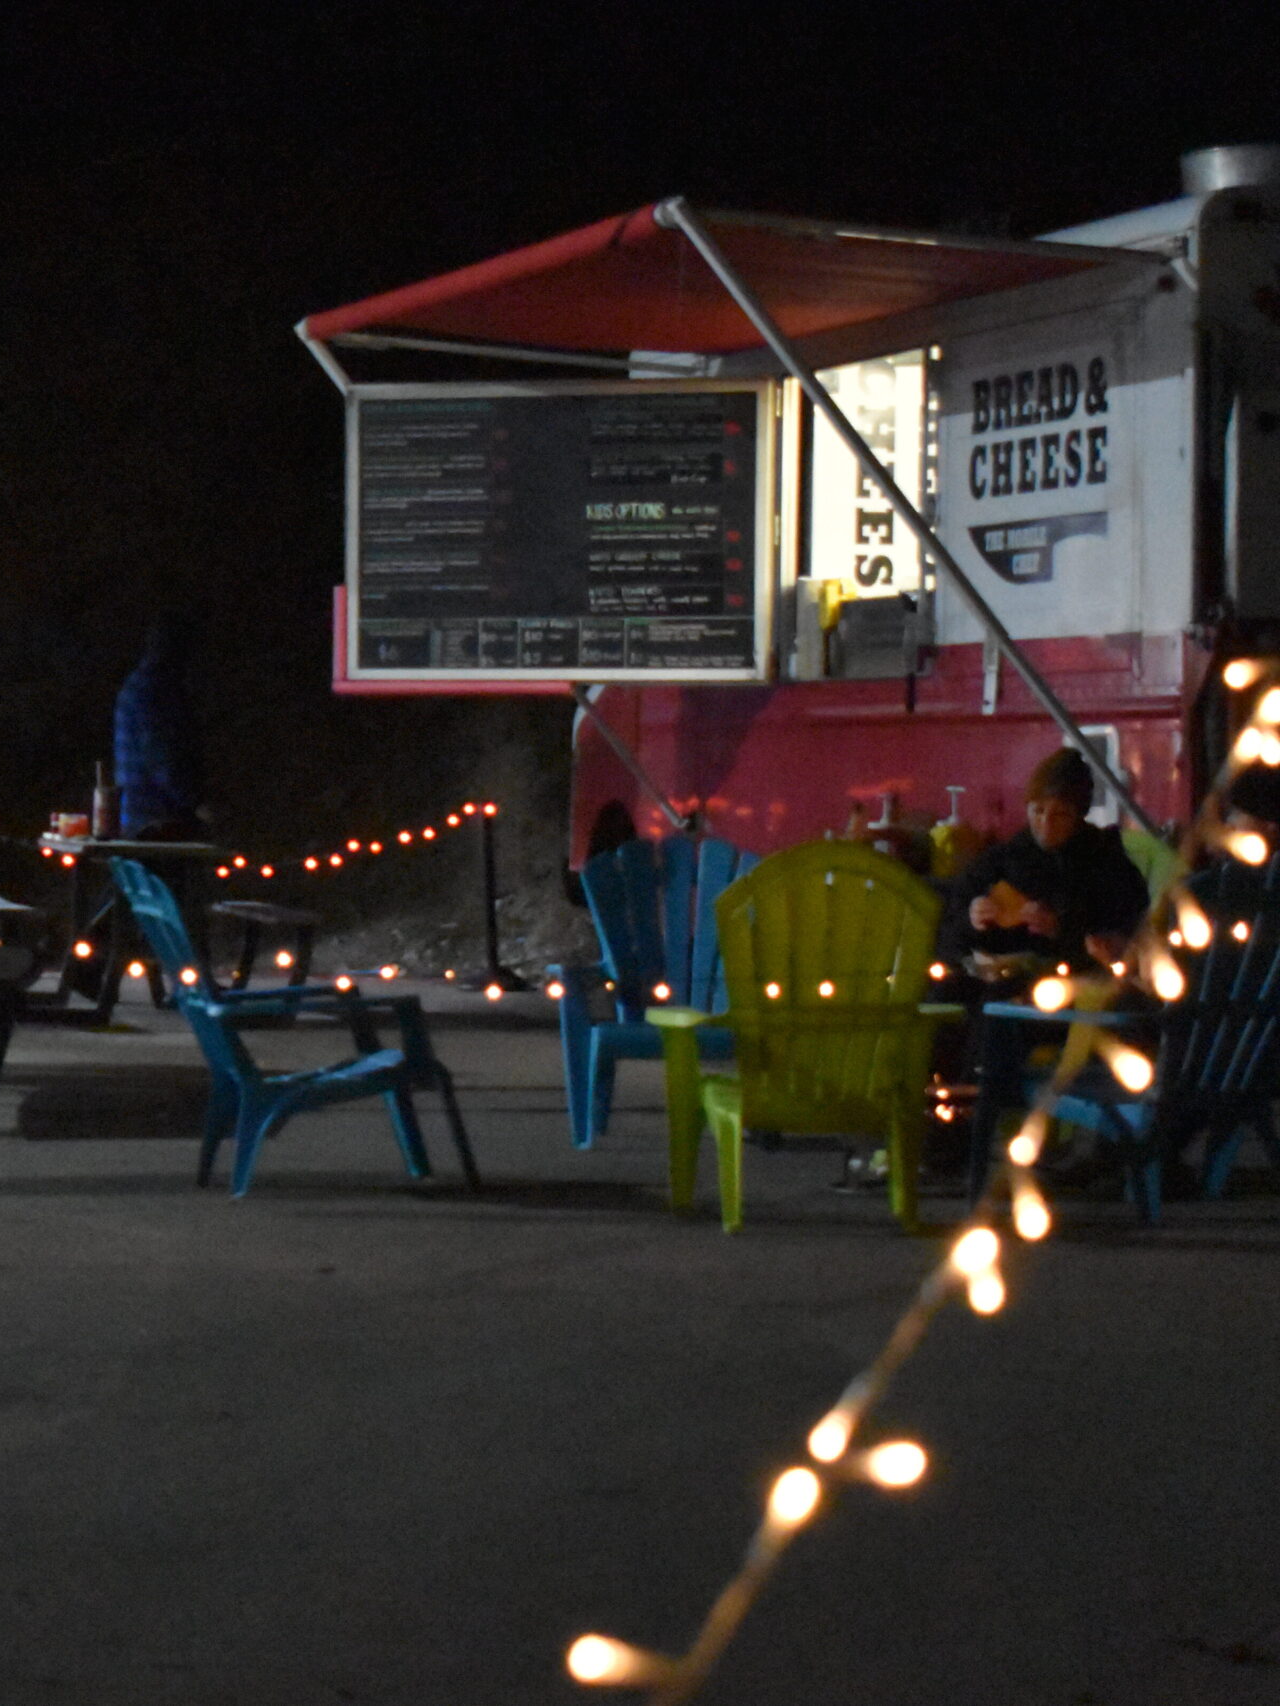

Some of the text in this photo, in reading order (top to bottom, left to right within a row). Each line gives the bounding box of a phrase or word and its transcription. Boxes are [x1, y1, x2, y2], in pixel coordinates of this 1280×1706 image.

[972, 357, 1108, 434] BREAD &
[970, 427, 1108, 500] CHEESE
